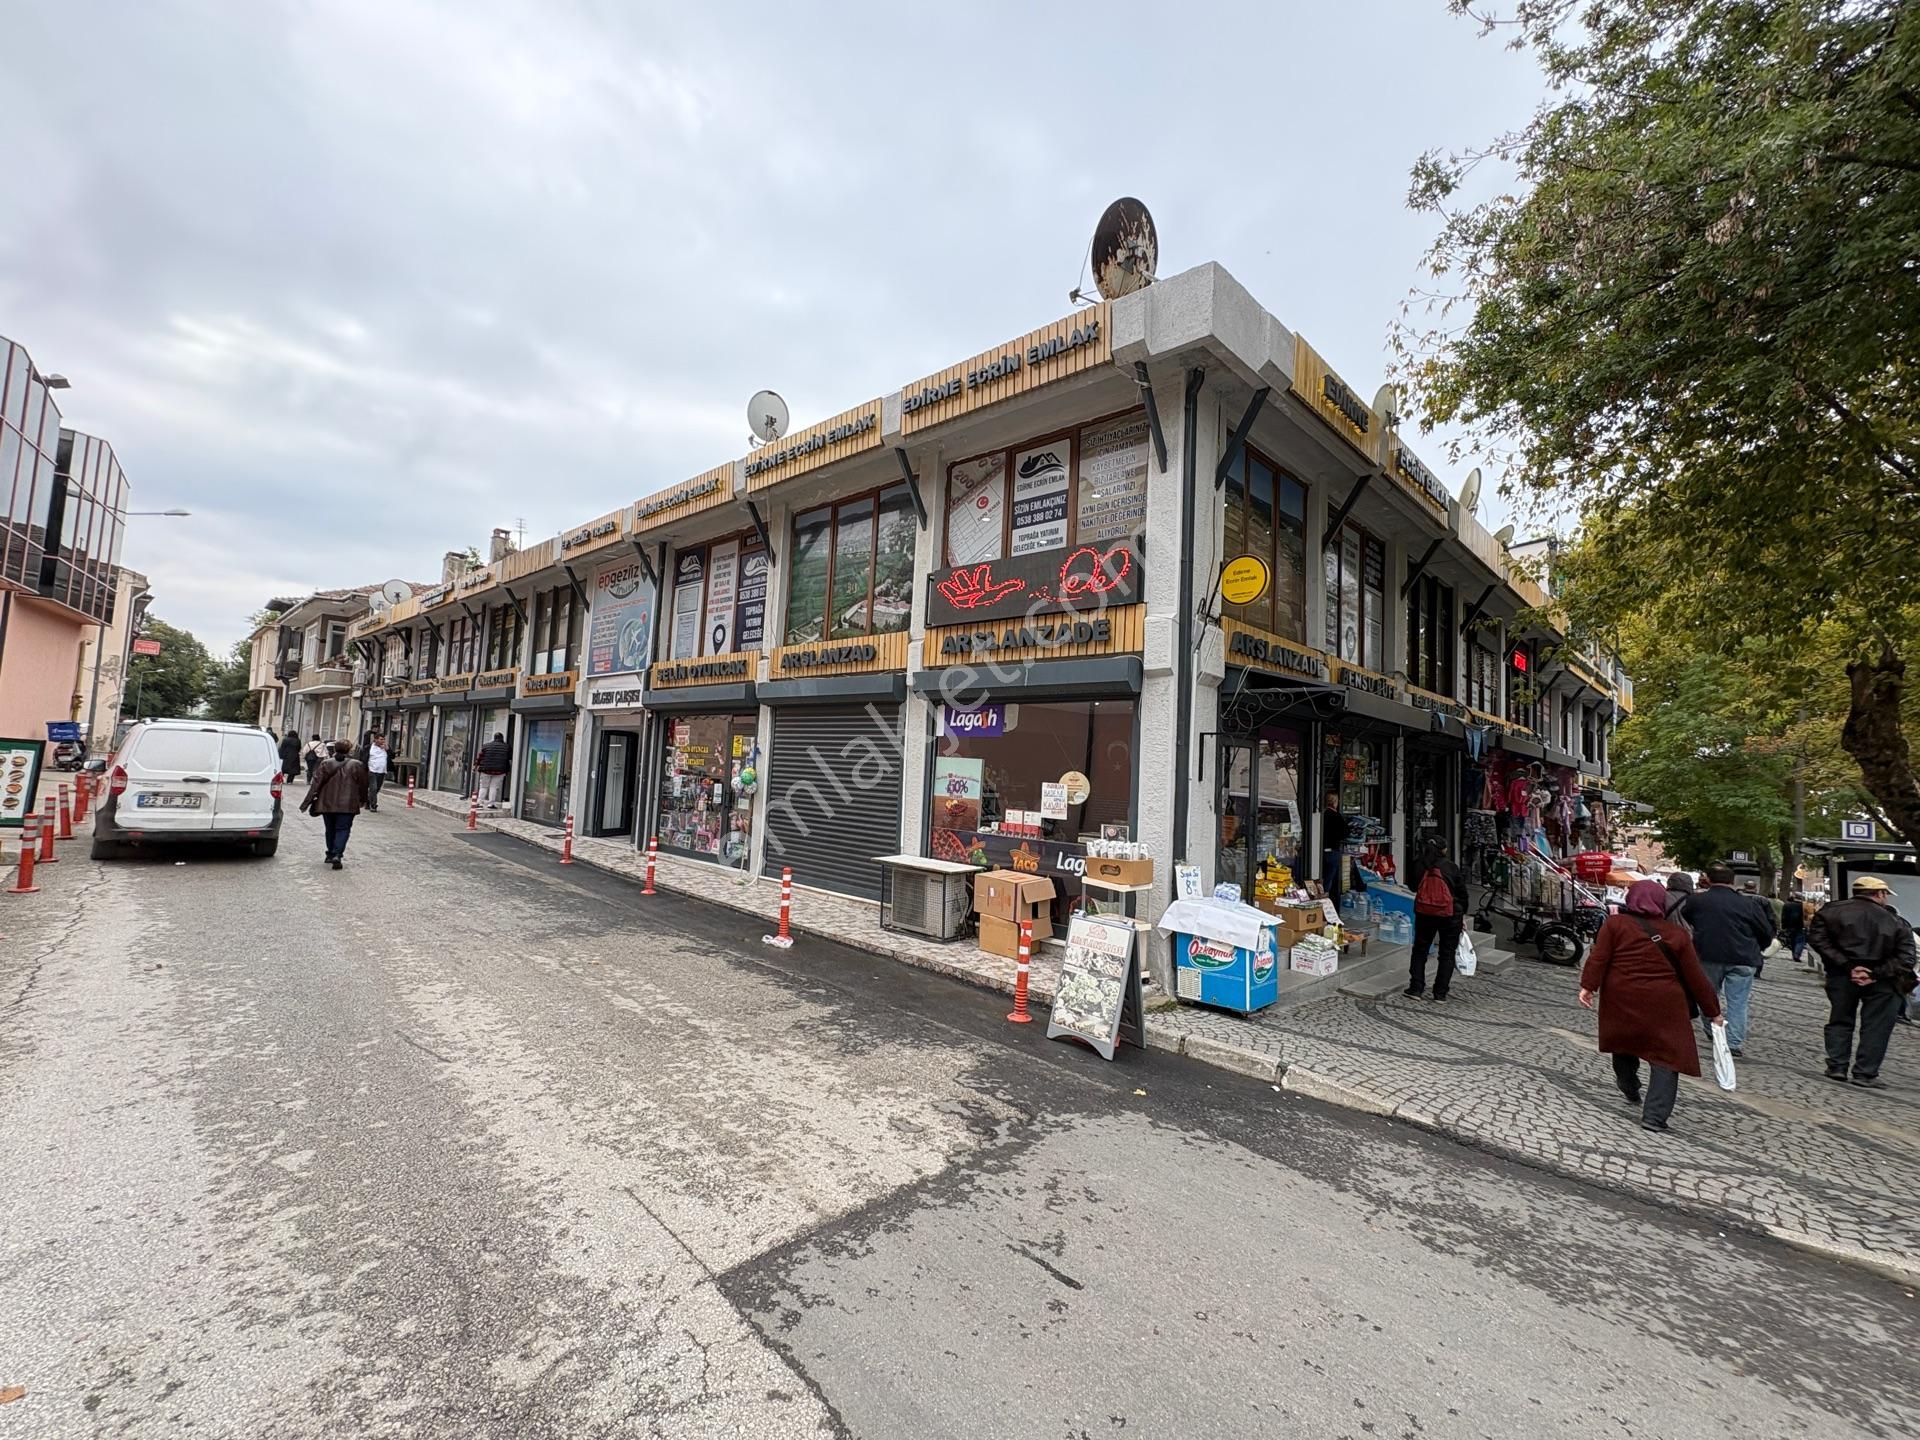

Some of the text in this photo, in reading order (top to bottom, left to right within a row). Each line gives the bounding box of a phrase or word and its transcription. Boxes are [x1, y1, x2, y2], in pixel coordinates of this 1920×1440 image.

[902, 321, 1100, 414] EDİRNE ECRİN EMLAK
[744, 413, 876, 477] EDİRNE ECRİN EMLAK
[1014, 502, 1029, 515] SİZİN
[1044, 510, 1053, 520] 02
[1054, 508, 1063, 518] 74
[1097, 525, 1128, 539] ALIYORUZ
[941, 618, 1110, 655] ARSLANZADE
[780, 644, 877, 669] ARSLANZAD
[1229, 630, 1326, 678] ARSLANZADE
[656, 659, 748, 682] SELİN OYUNCAK
[949, 709, 997, 731] Lagash
[180, 797, 199, 805] 732
[1854, 825, 1865, 836] D
[1012, 856, 1039, 873] TACO
[1185, 879, 1193, 896] 8
